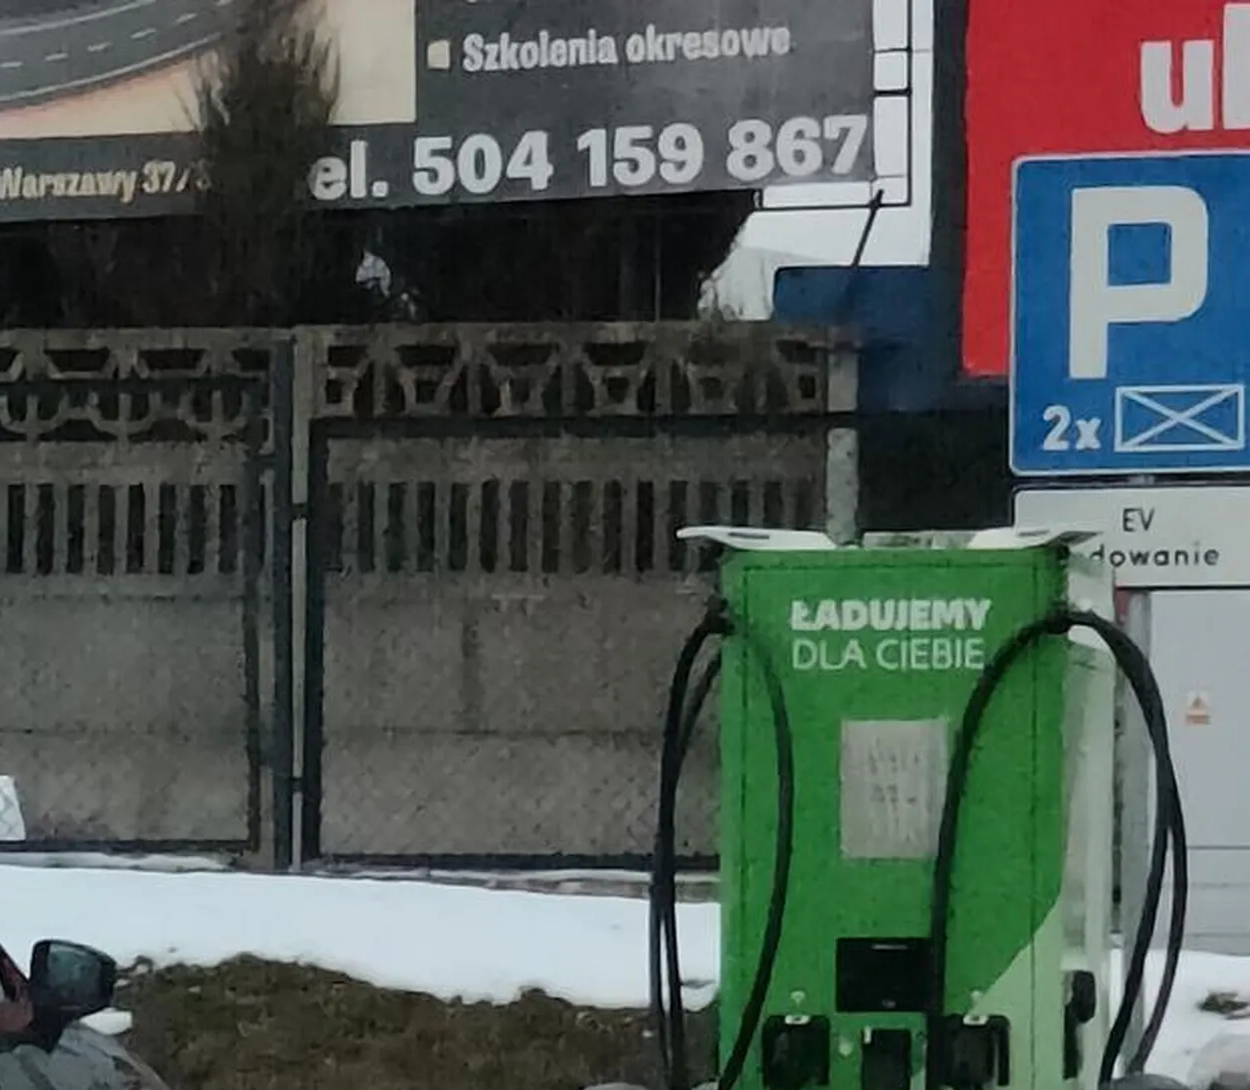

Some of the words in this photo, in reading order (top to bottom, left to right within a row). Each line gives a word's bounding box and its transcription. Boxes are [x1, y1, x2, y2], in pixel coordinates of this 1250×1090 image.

[462, 30, 616, 72] Szkolenia
[627, 24, 790, 61] okresowe
[307, 140, 389, 201] el.
[413, 131, 553, 196] 504
[577, 123, 704, 187] 159
[726, 115, 869, 180] 867
[1069, 185, 1209, 379] P
[1043, 405, 1102, 451] 2x
[1123, 508, 1155, 532] EV
[1090, 542, 1220, 567] dowanie
[790, 598, 991, 631] ŁADUJEMY
[792, 638, 866, 670] DLA
[876, 637, 985, 670] CIEBIE
